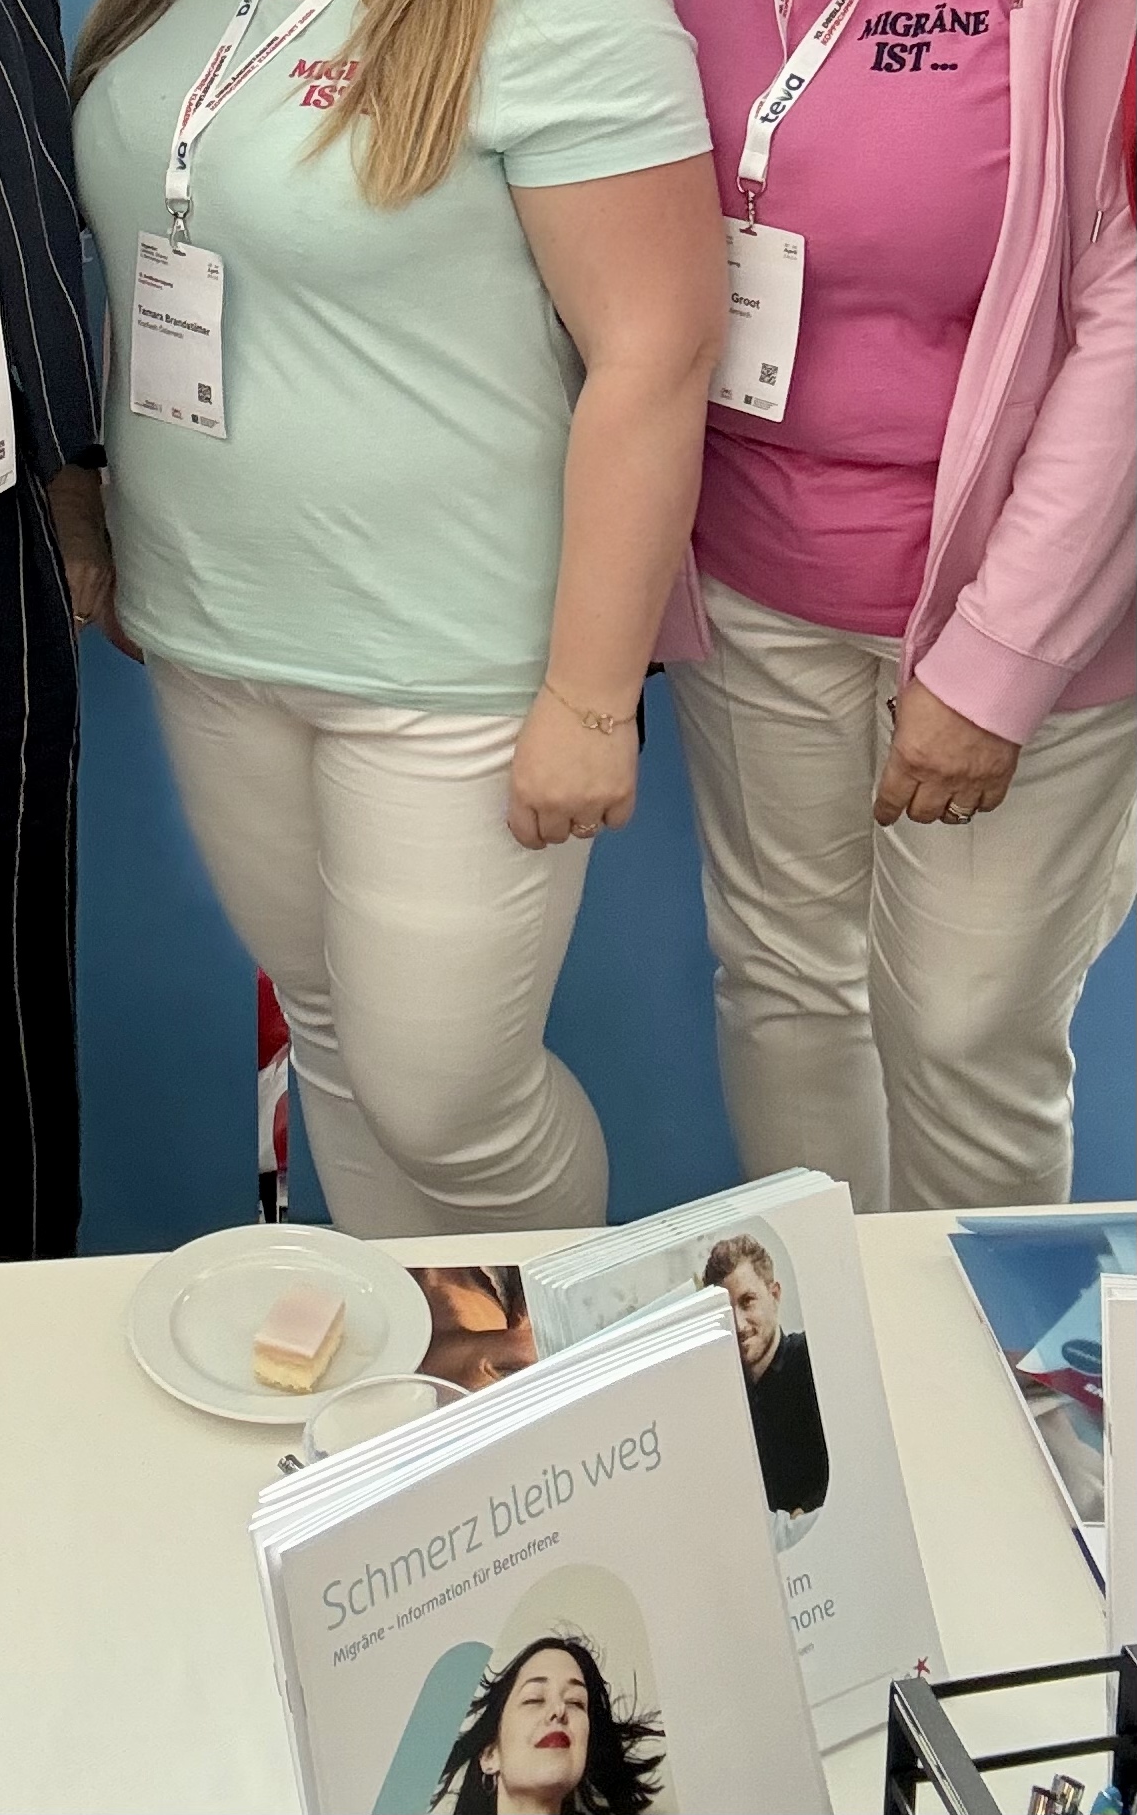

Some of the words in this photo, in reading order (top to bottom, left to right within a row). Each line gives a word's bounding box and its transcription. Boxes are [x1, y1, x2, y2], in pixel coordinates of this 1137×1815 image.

[857, 2, 989, 41] MIGRÄNE
[760, 72, 806, 124] teva
[731, 292, 760, 310] Groot
[322, 1515, 483, 1632] Schmerz
[489, 1464, 574, 1538] bleib
[581, 1420, 662, 1488] weg
[333, 1626, 386, 1668] Migräne
[396, 1576, 472, 1631] Information
[472, 1566, 492, 1592] für
[493, 1531, 560, 1577] Betroffene
